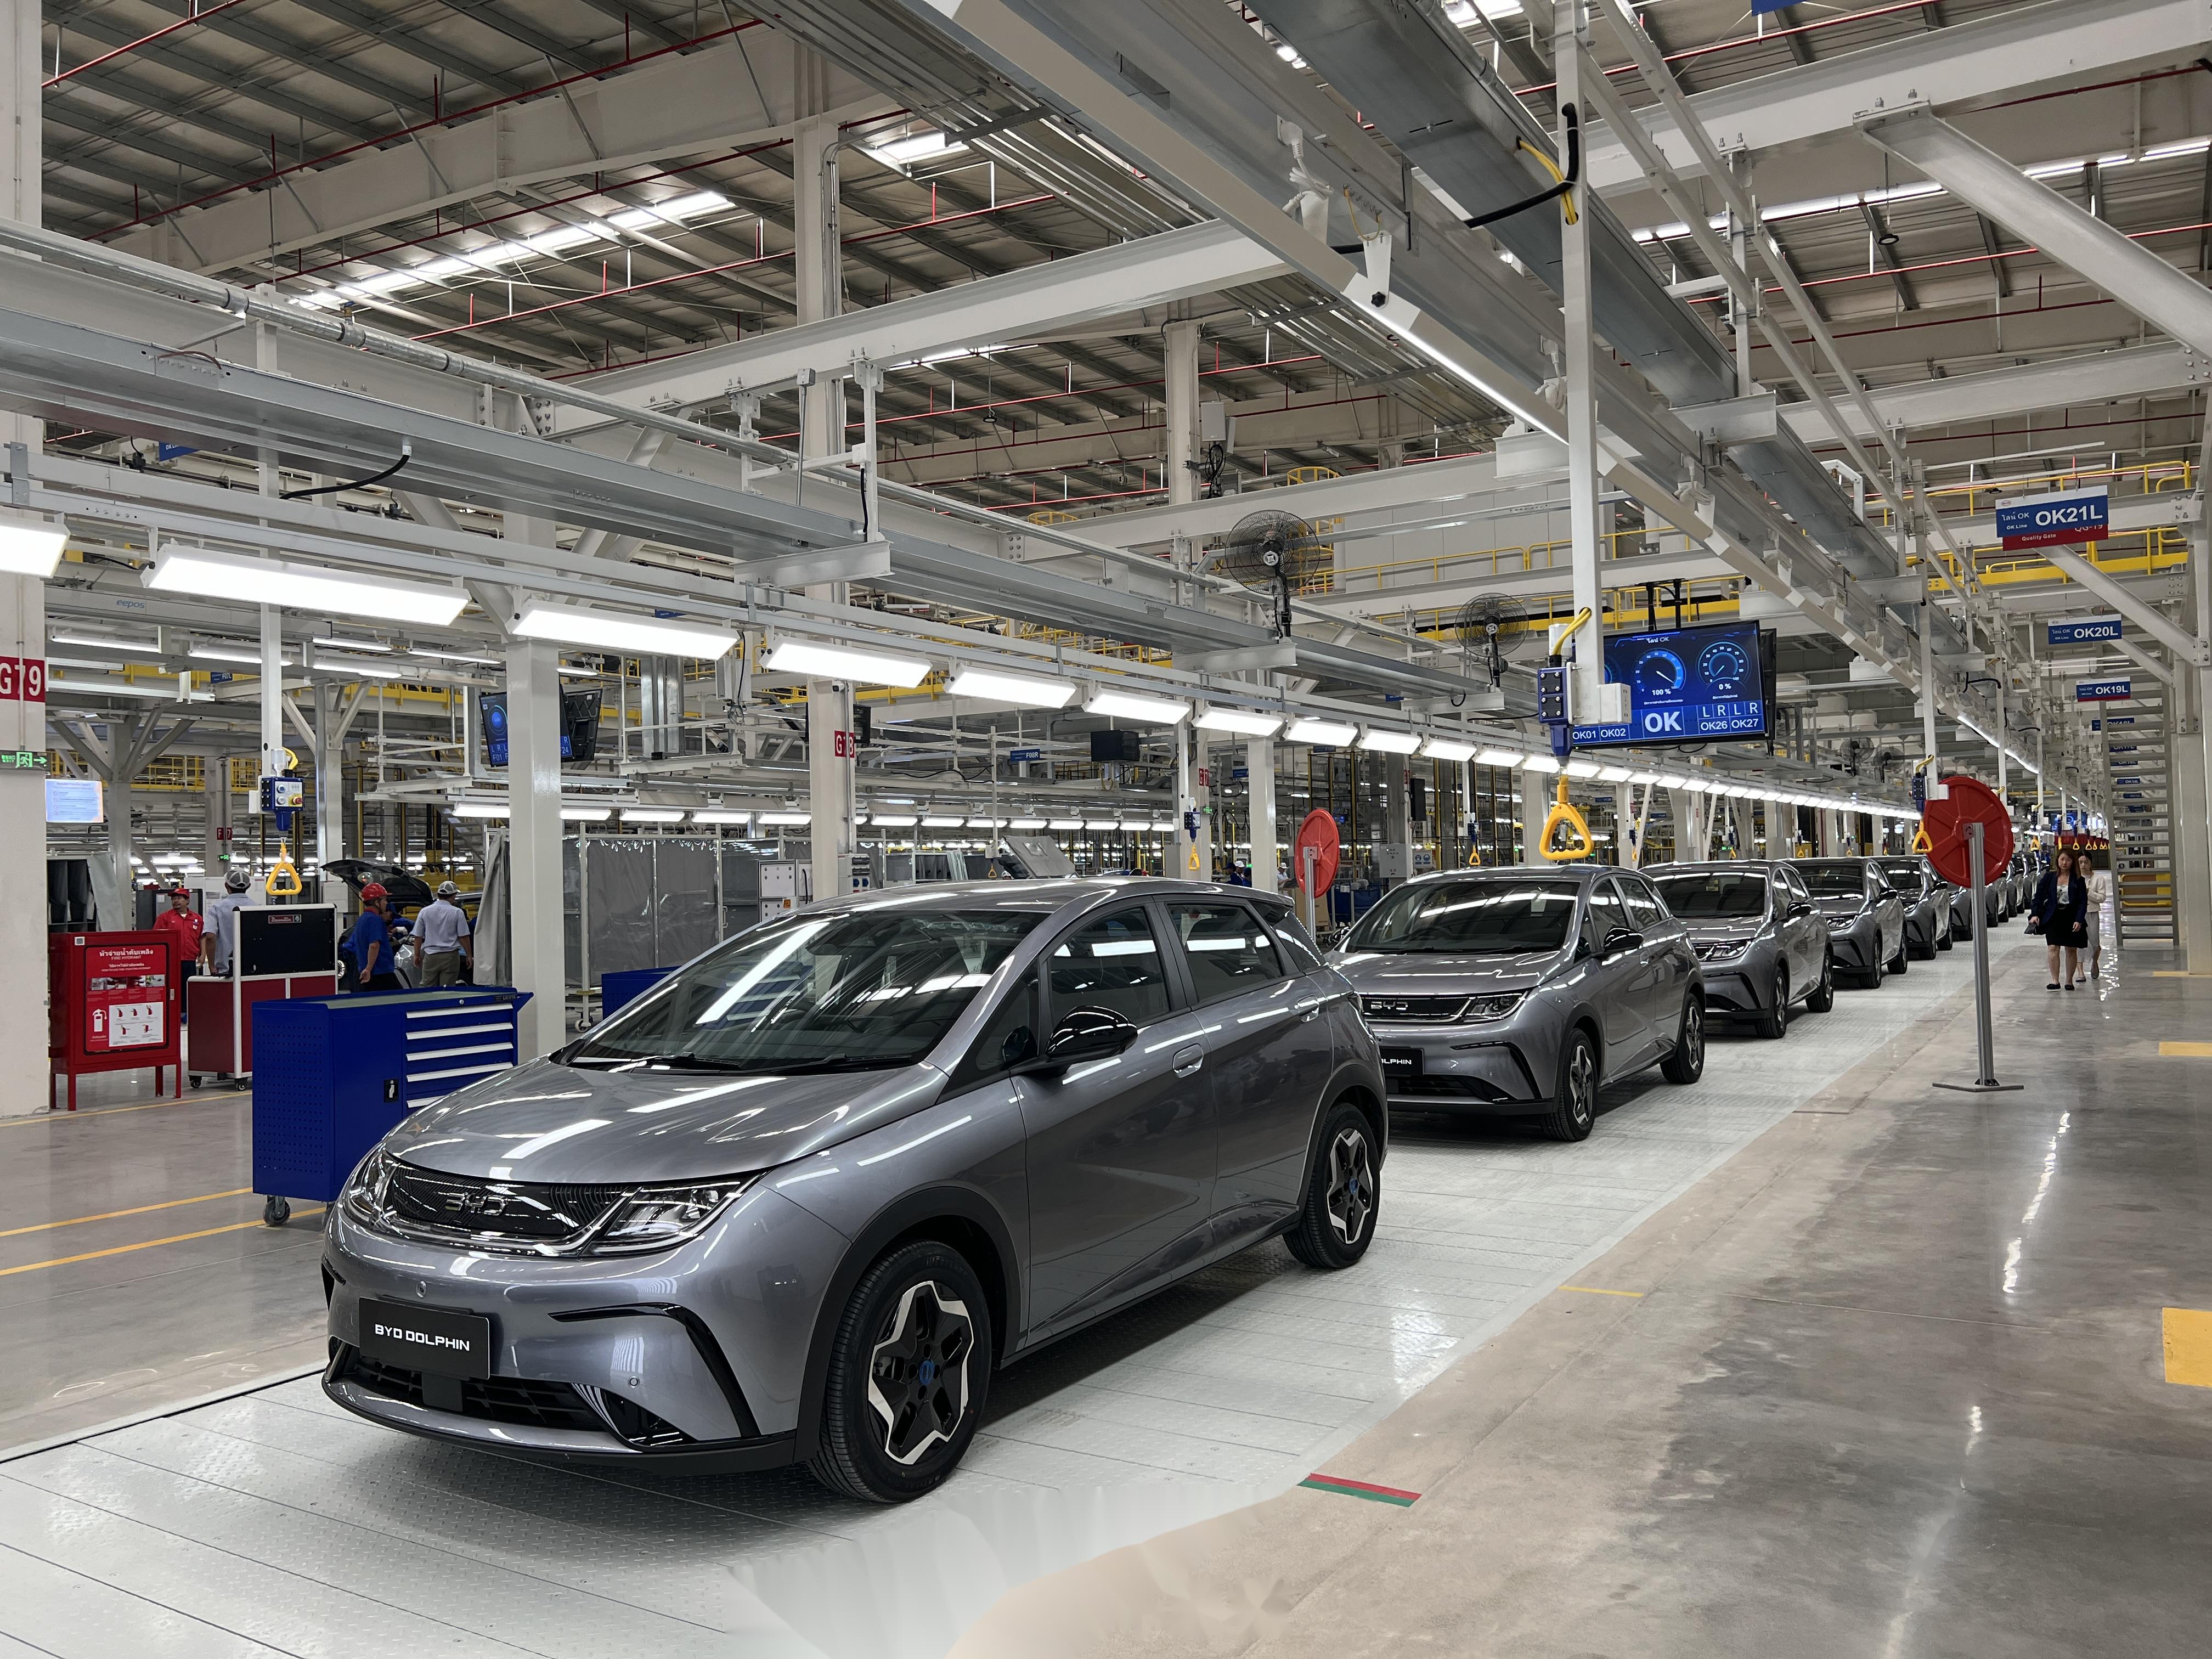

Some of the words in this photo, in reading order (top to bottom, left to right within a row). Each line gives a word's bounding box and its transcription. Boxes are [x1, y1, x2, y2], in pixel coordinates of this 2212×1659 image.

[2035, 505, 2103, 526] OK21L
[116, 600, 145, 609] eepos
[2074, 626, 2119, 639] OK20L
[2095, 685, 2129, 695] OK19L
[1702, 706, 1711, 717] L
[1717, 704, 1726, 716] R
[1734, 703, 1741, 715] L
[1749, 702, 1758, 714] R
[1645, 711, 1682, 732] OK
[1700, 720, 1728, 731] OK26
[1731, 718, 1759, 729] OK27
[1572, 730, 1596, 740] OK01
[1600, 728, 1626, 738] OK02
[836, 735, 854, 755] G8
[1199, 770, 1208, 785] G7
[218, 828, 231, 839] F7
[375, 1324, 403, 1339] BYD
[405, 1330, 470, 1351] DOLPHIN
